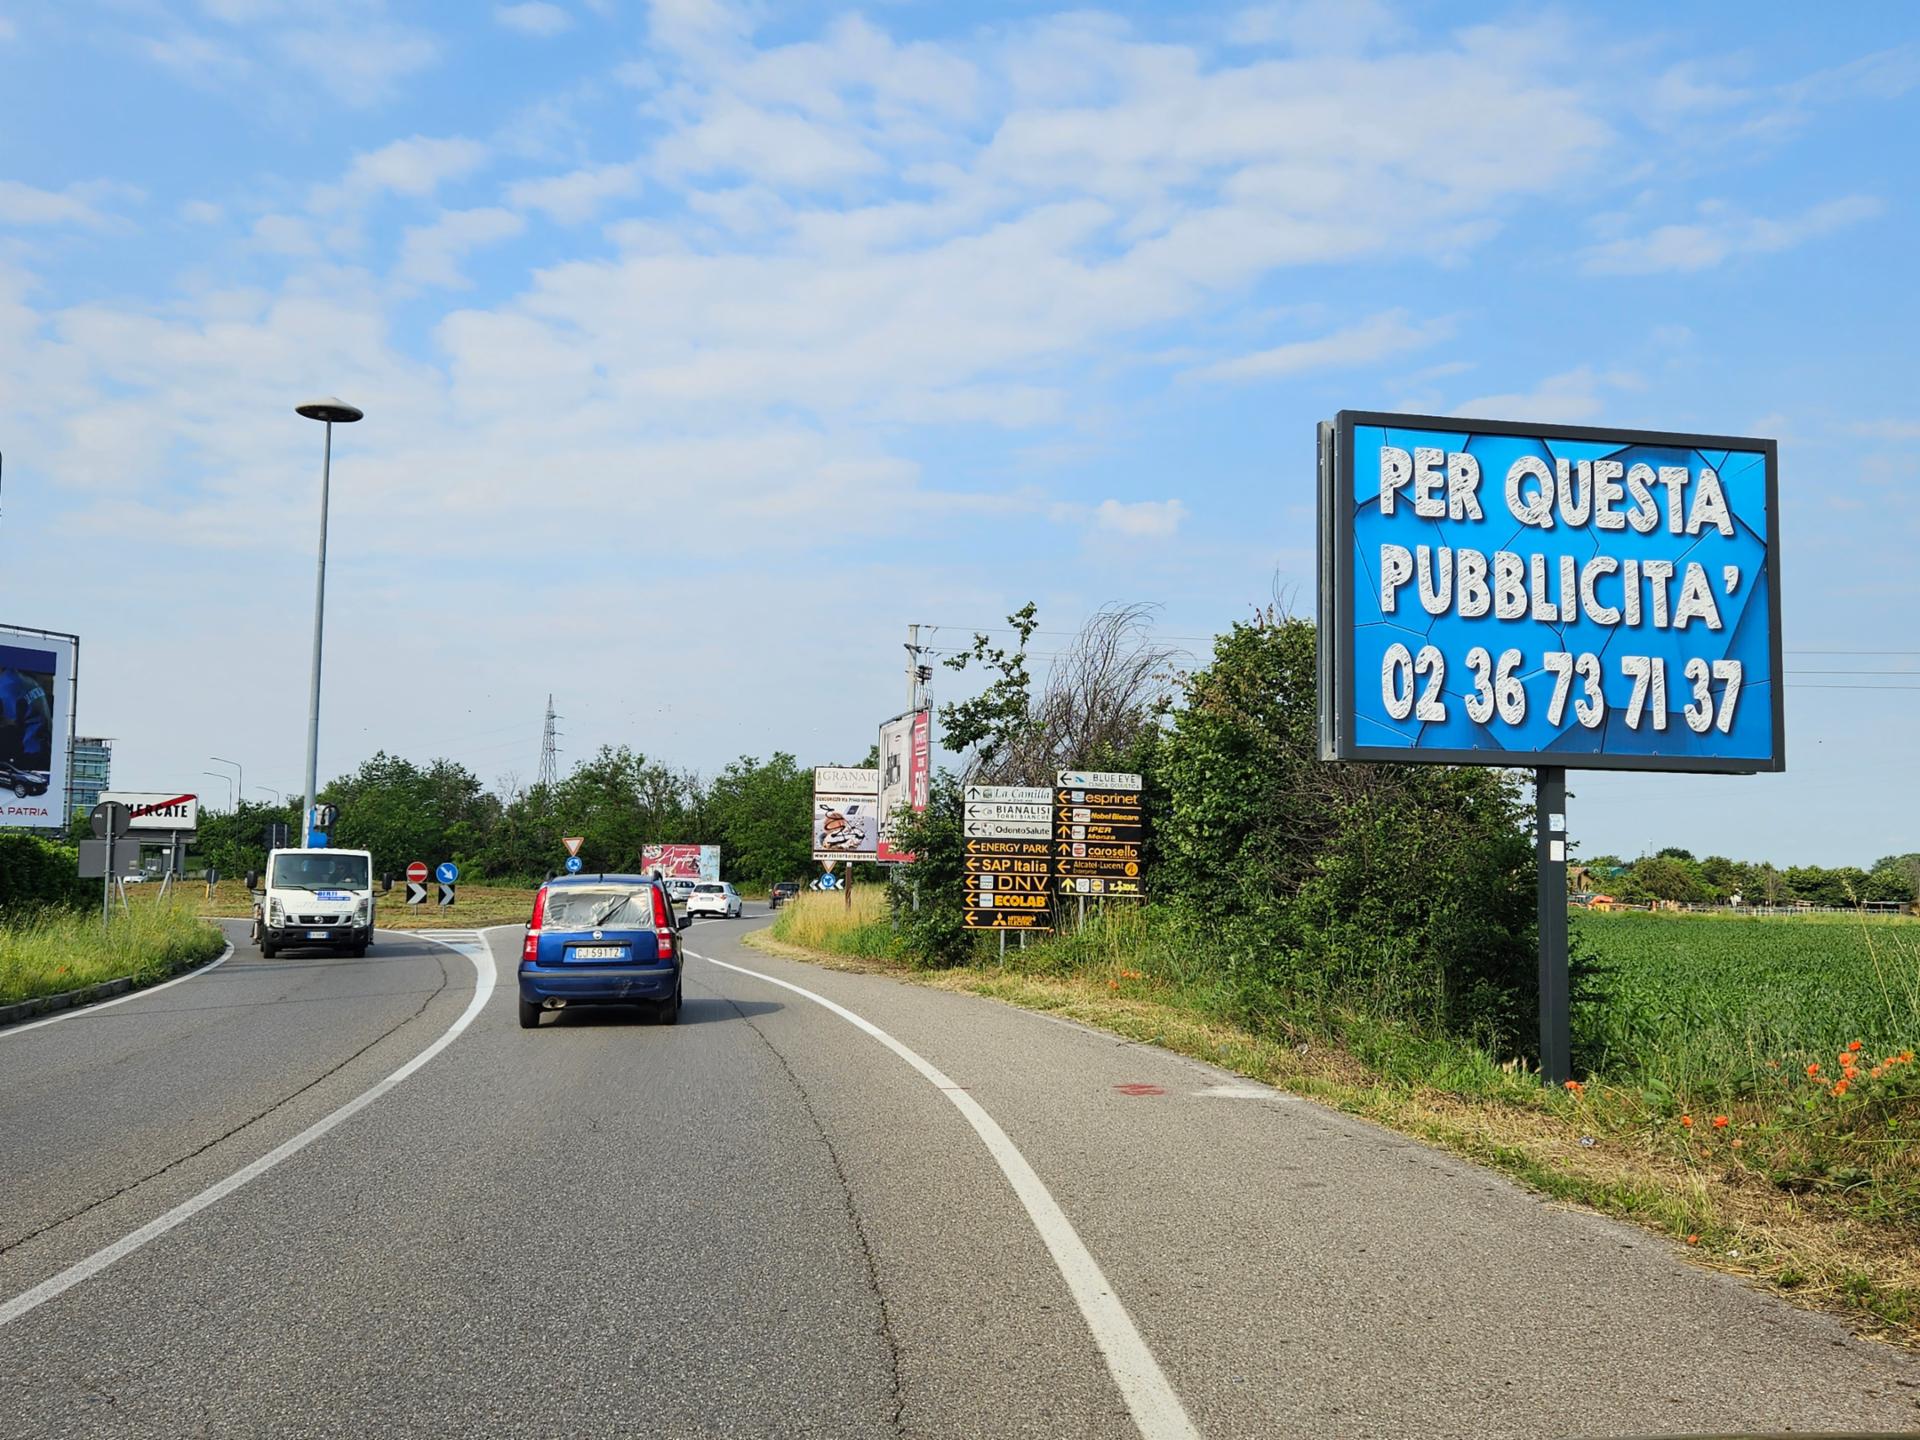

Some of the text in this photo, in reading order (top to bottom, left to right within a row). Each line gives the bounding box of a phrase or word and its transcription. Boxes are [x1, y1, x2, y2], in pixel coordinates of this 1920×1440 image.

[1379, 446, 1735, 537] PER QUESTA
[1380, 543, 1740, 630] PUBBLICITA'
[1381, 642, 1743, 734] 02 36 73 71 37
[1093, 773, 1137, 784] BLUE EYE
[995, 788, 1050, 800] La Camilla
[1085, 792, 1139, 806] esprinet
[8, 806, 49, 816] PATRIA
[124, 802, 188, 818] MERCATE
[996, 805, 1050, 816] BIANALISI
[995, 825, 1050, 835] OdontoSalute
[1088, 826, 1113, 834] IPER
[1087, 833, 1116, 841] Monza
[981, 842, 1049, 854] ENERGY PARK
[1088, 844, 1138, 857] carosello
[982, 859, 1048, 873] SAP Italia
[998, 875, 1048, 891] DNV
[994, 894, 1047, 907] ECOLAB
